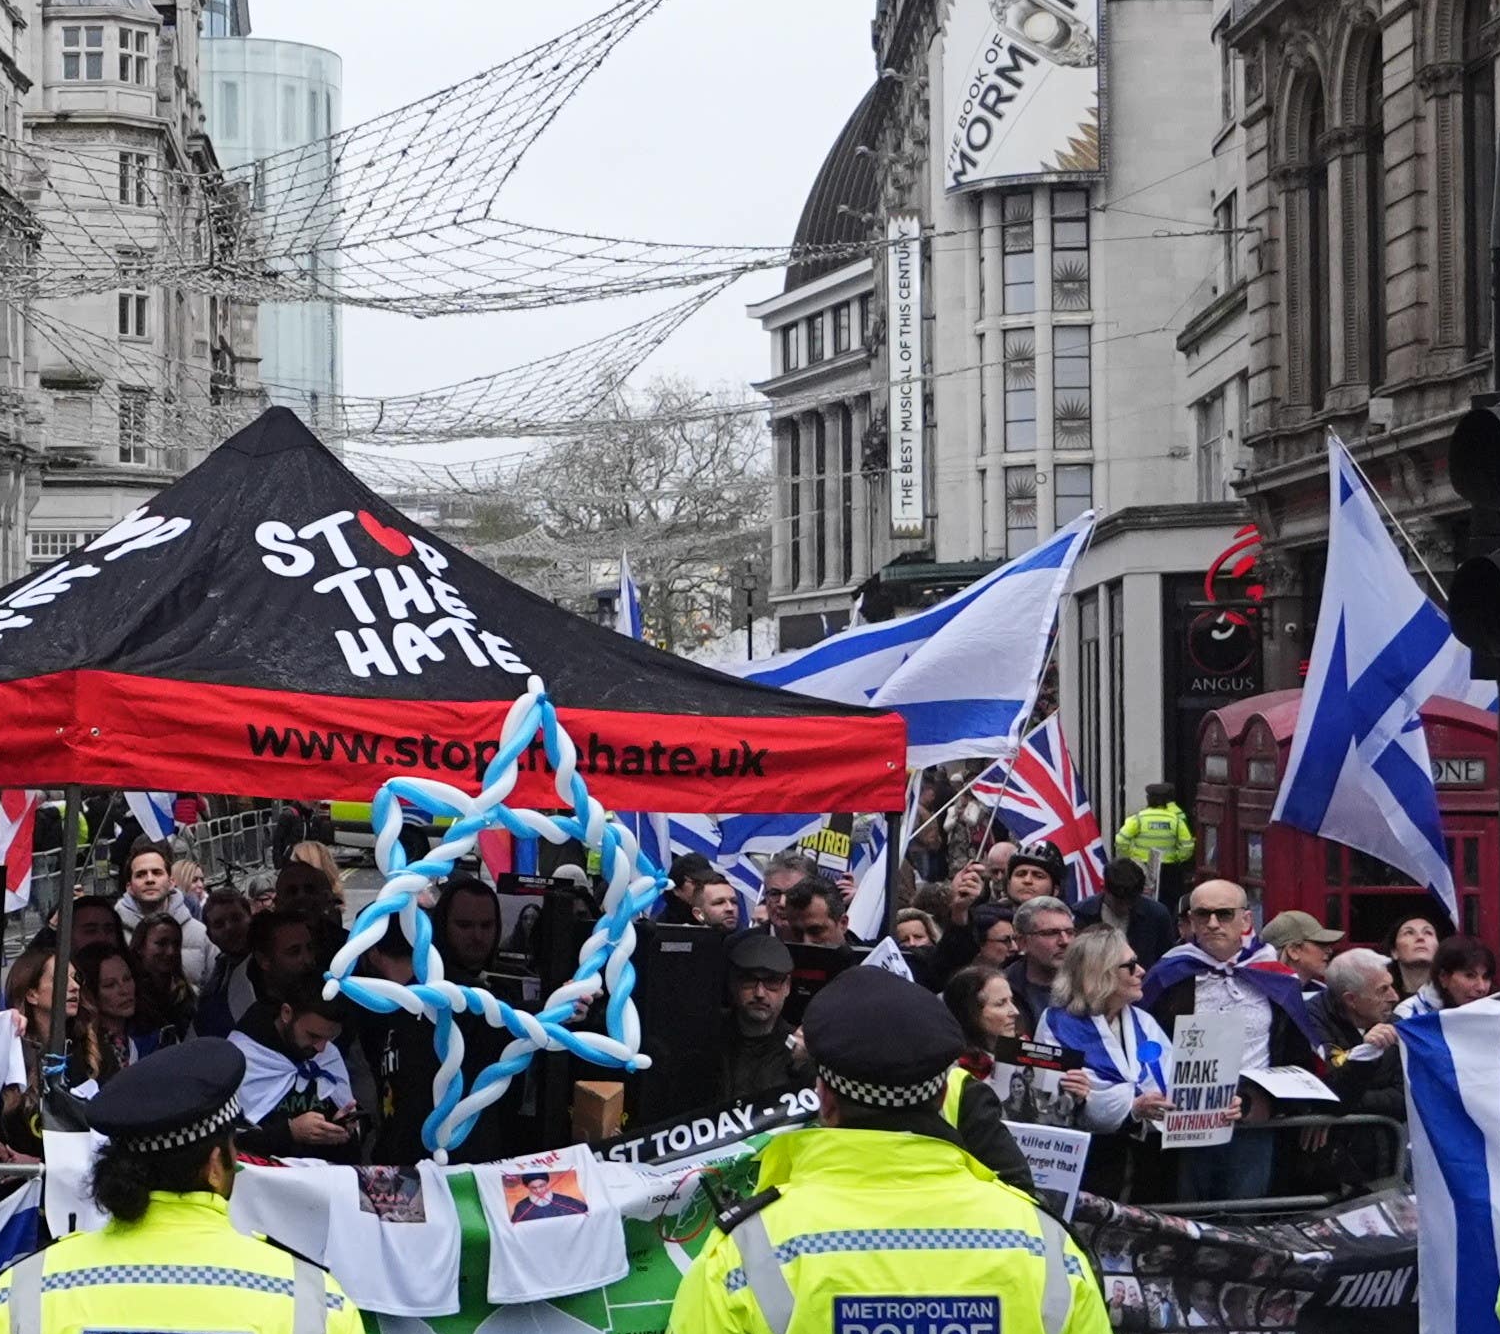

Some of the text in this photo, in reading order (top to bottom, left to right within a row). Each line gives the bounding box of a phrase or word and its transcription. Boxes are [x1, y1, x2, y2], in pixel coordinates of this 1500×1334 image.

[947, 33, 1005, 171] THE BOOK OF
[899, 229, 914, 508] THE BEST MUSICAL OF THIS CENTURY
[313, 563, 478, 625] THE
[334, 616, 534, 678] HATE
[1190, 676, 1254, 692] ANGUS
[1173, 1059, 1219, 1085] MAKE
[650, 1104, 755, 1158] TODAY
[1020, 1135, 1052, 1151] killed
[1056, 1159, 1078, 1174] that
[1324, 1268, 1408, 1309] TURN
[841, 1301, 994, 1320] METROPOLITAN
